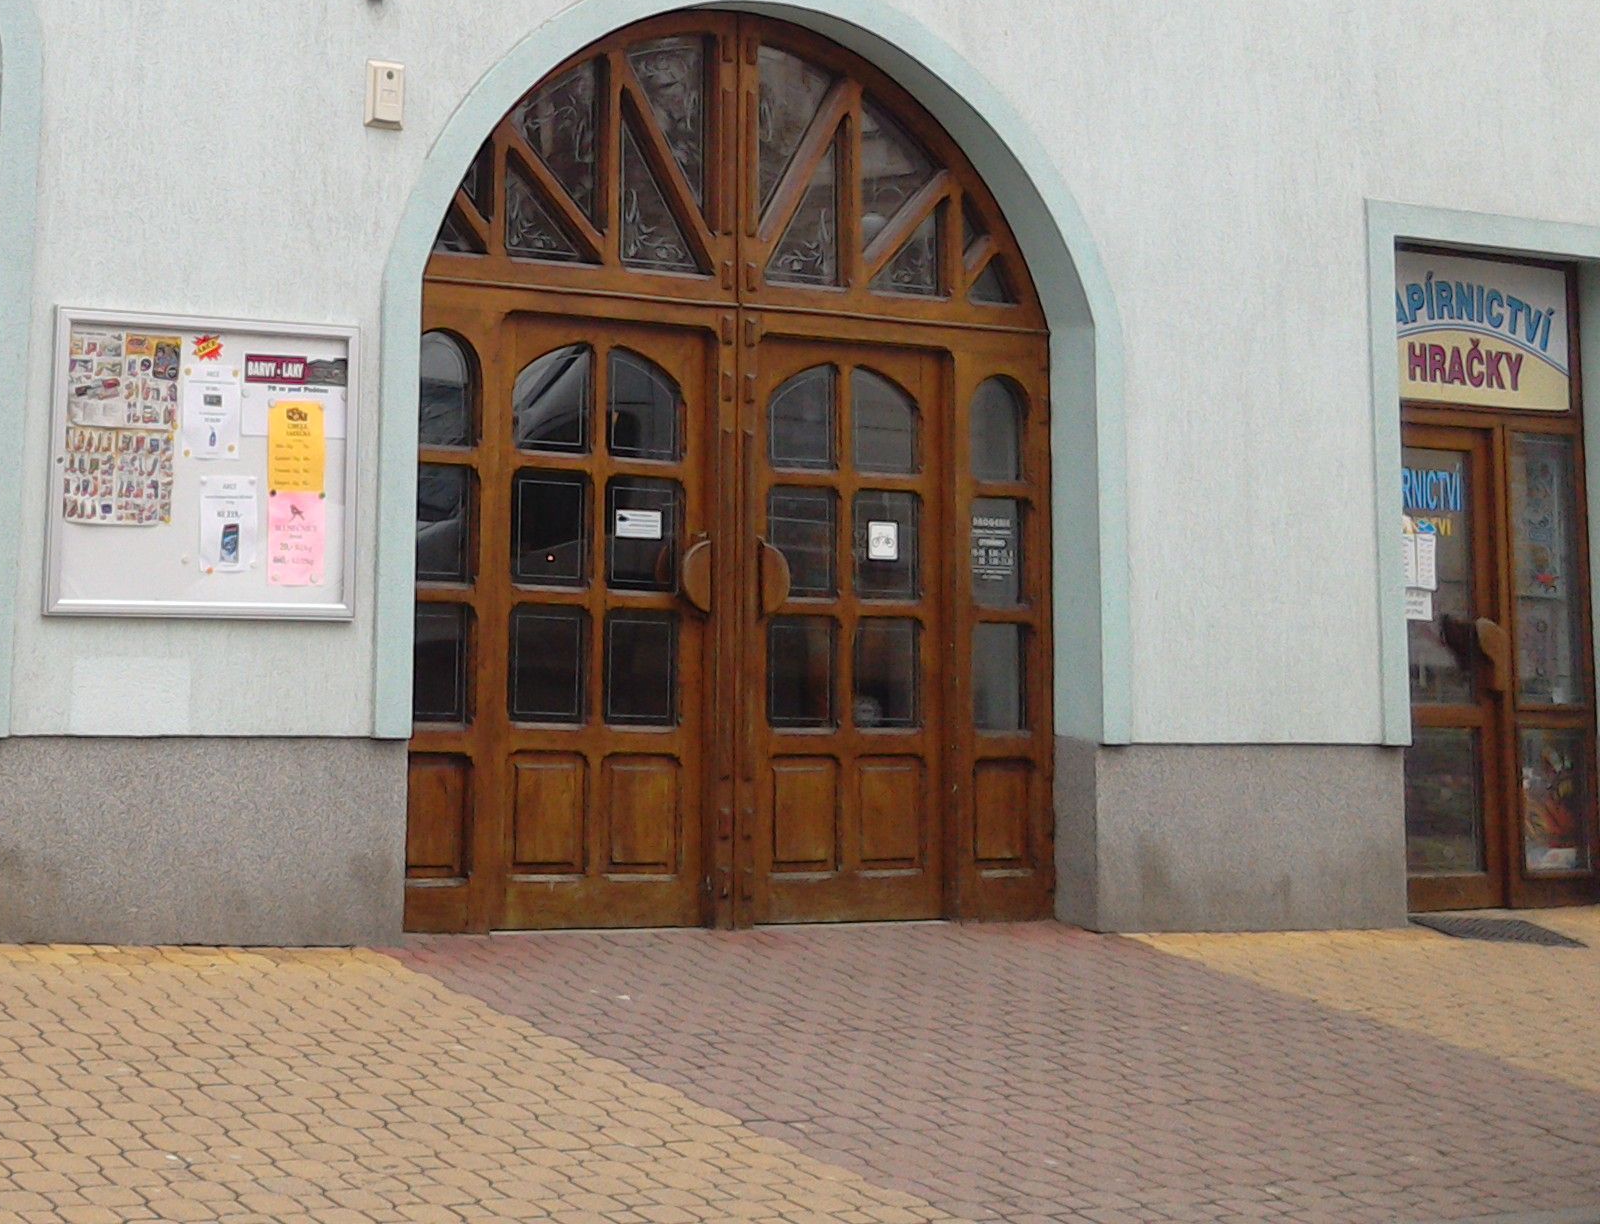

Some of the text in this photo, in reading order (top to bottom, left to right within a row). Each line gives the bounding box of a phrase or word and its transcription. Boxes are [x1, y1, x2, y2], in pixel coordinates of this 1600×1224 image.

[247, 361, 304, 379] BARVY LAKY
[1407, 338, 1524, 392] HRAČKY
